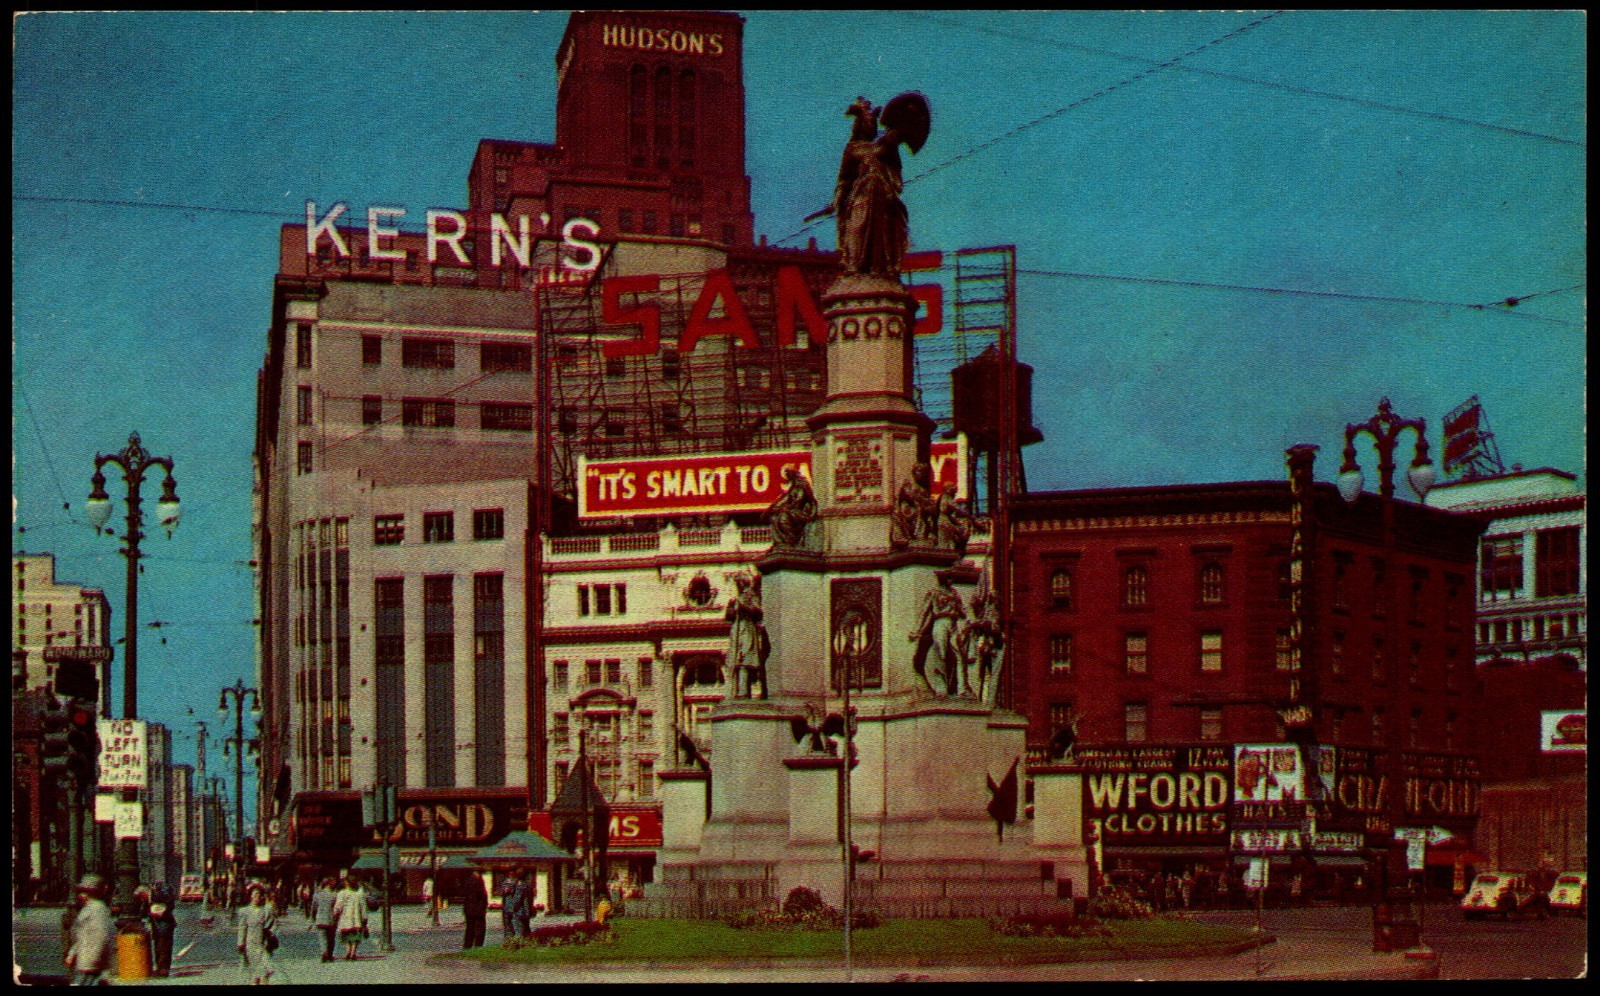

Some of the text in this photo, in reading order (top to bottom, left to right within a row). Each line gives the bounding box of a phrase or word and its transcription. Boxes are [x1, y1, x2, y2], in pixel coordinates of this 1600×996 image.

[602, 23, 725, 55] HUDSON'S
[305, 200, 603, 271] KERN'S
[646, 466, 732, 499] SMART
[737, 464, 770, 492] TO
[111, 721, 133, 735] NO
[105, 737, 139, 752] LEFT
[104, 754, 141, 768] TURN
[1104, 812, 1228, 834] CLOTHES
